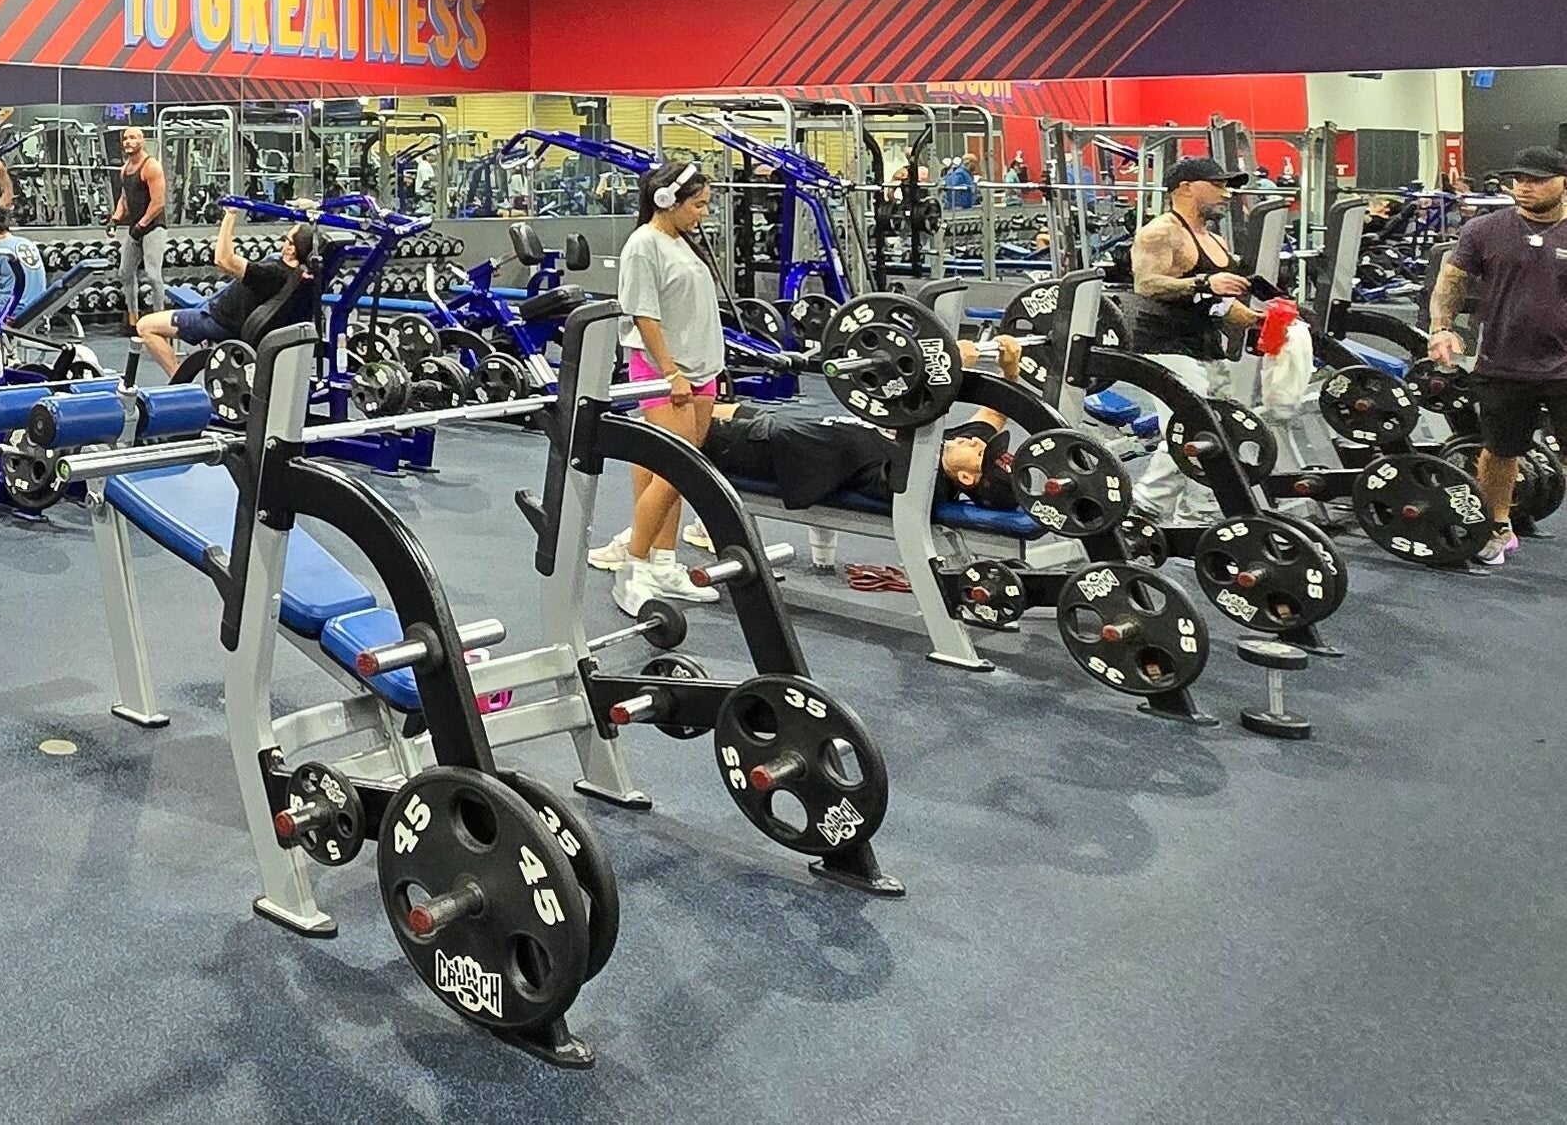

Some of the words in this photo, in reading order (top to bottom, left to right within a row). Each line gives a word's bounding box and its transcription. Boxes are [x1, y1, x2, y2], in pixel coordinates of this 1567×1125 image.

[839, 304, 875, 333] 45
[886, 330, 907, 347] 10
[848, 389, 889, 416] 45
[1029, 437, 1056, 457] 25
[1367, 463, 1398, 489] 45
[1216, 522, 1249, 542] 35
[784, 687, 827, 718] 35
[721, 746, 748, 790] 35
[392, 794, 432, 855] 45
[538, 806, 582, 858] 35
[326, 842, 342, 861] 5
[518, 844, 566, 926] 45
